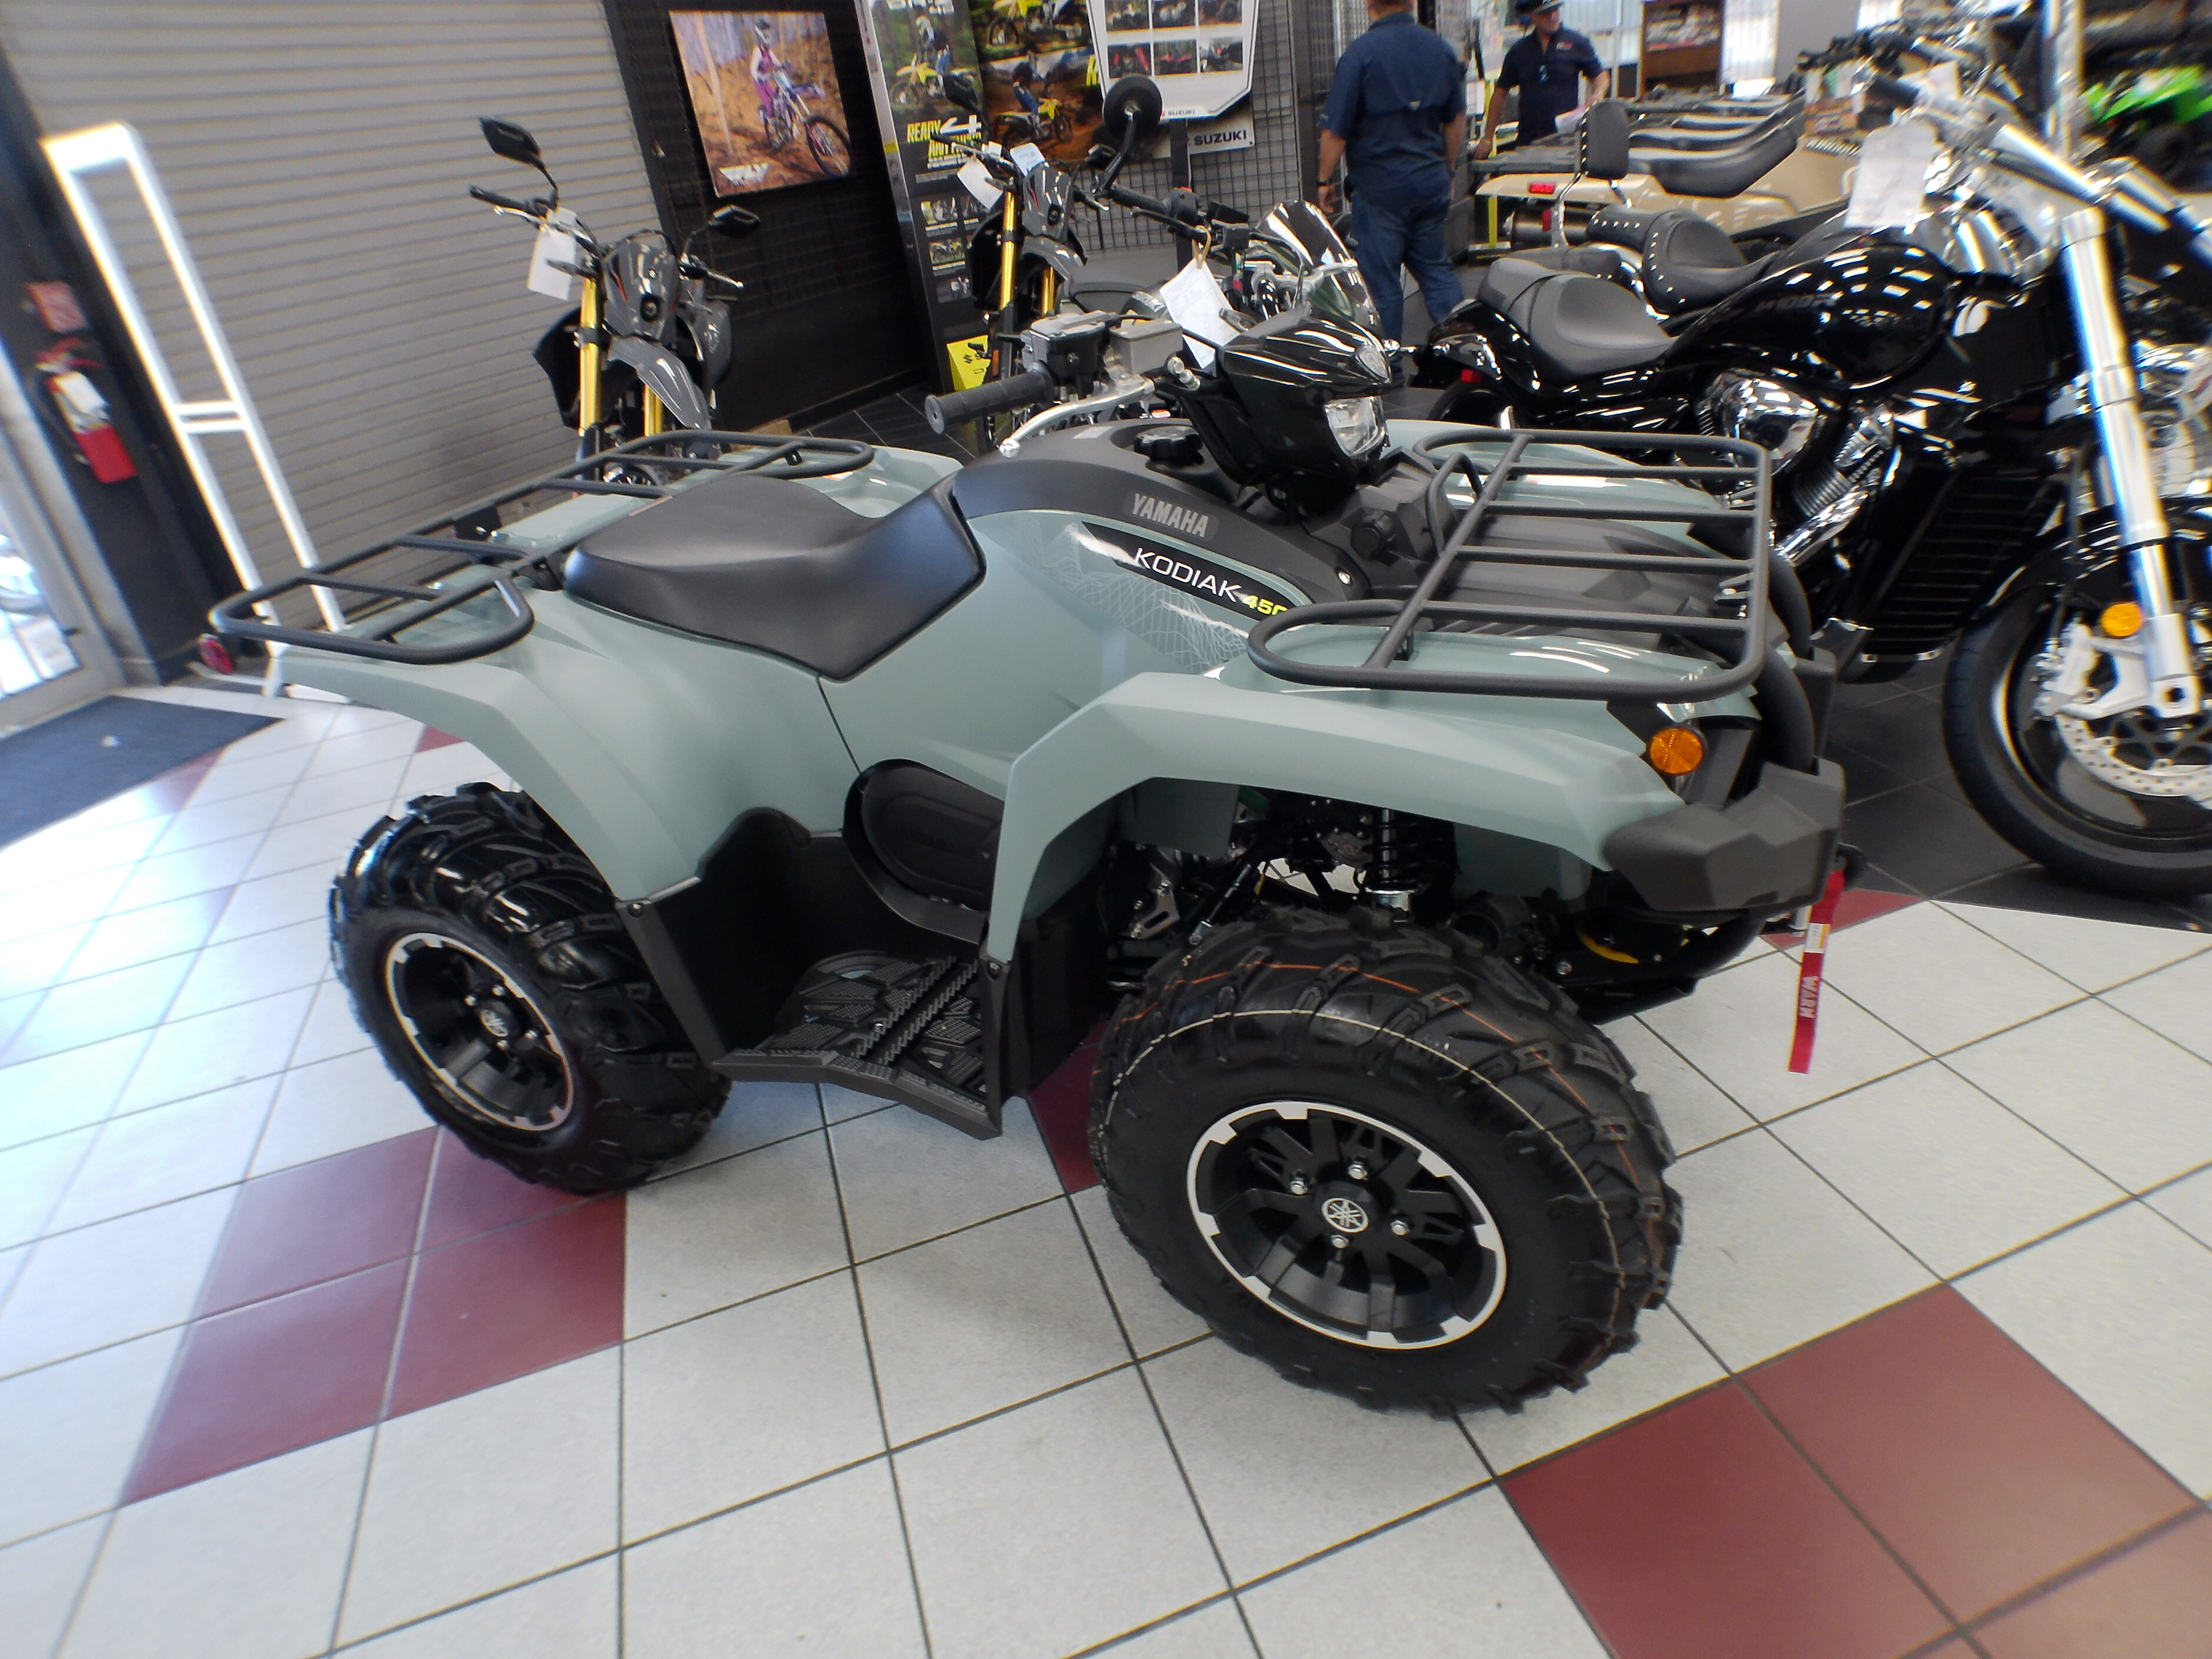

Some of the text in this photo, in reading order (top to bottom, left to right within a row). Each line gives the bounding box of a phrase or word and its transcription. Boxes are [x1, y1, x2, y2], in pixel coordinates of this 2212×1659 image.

[1194, 129, 1247, 146] SUZUKI
[1132, 493, 1209, 538] YAMAHA
[1135, 547, 1242, 603] KODIAK
[1798, 975, 1820, 1019] WARN
